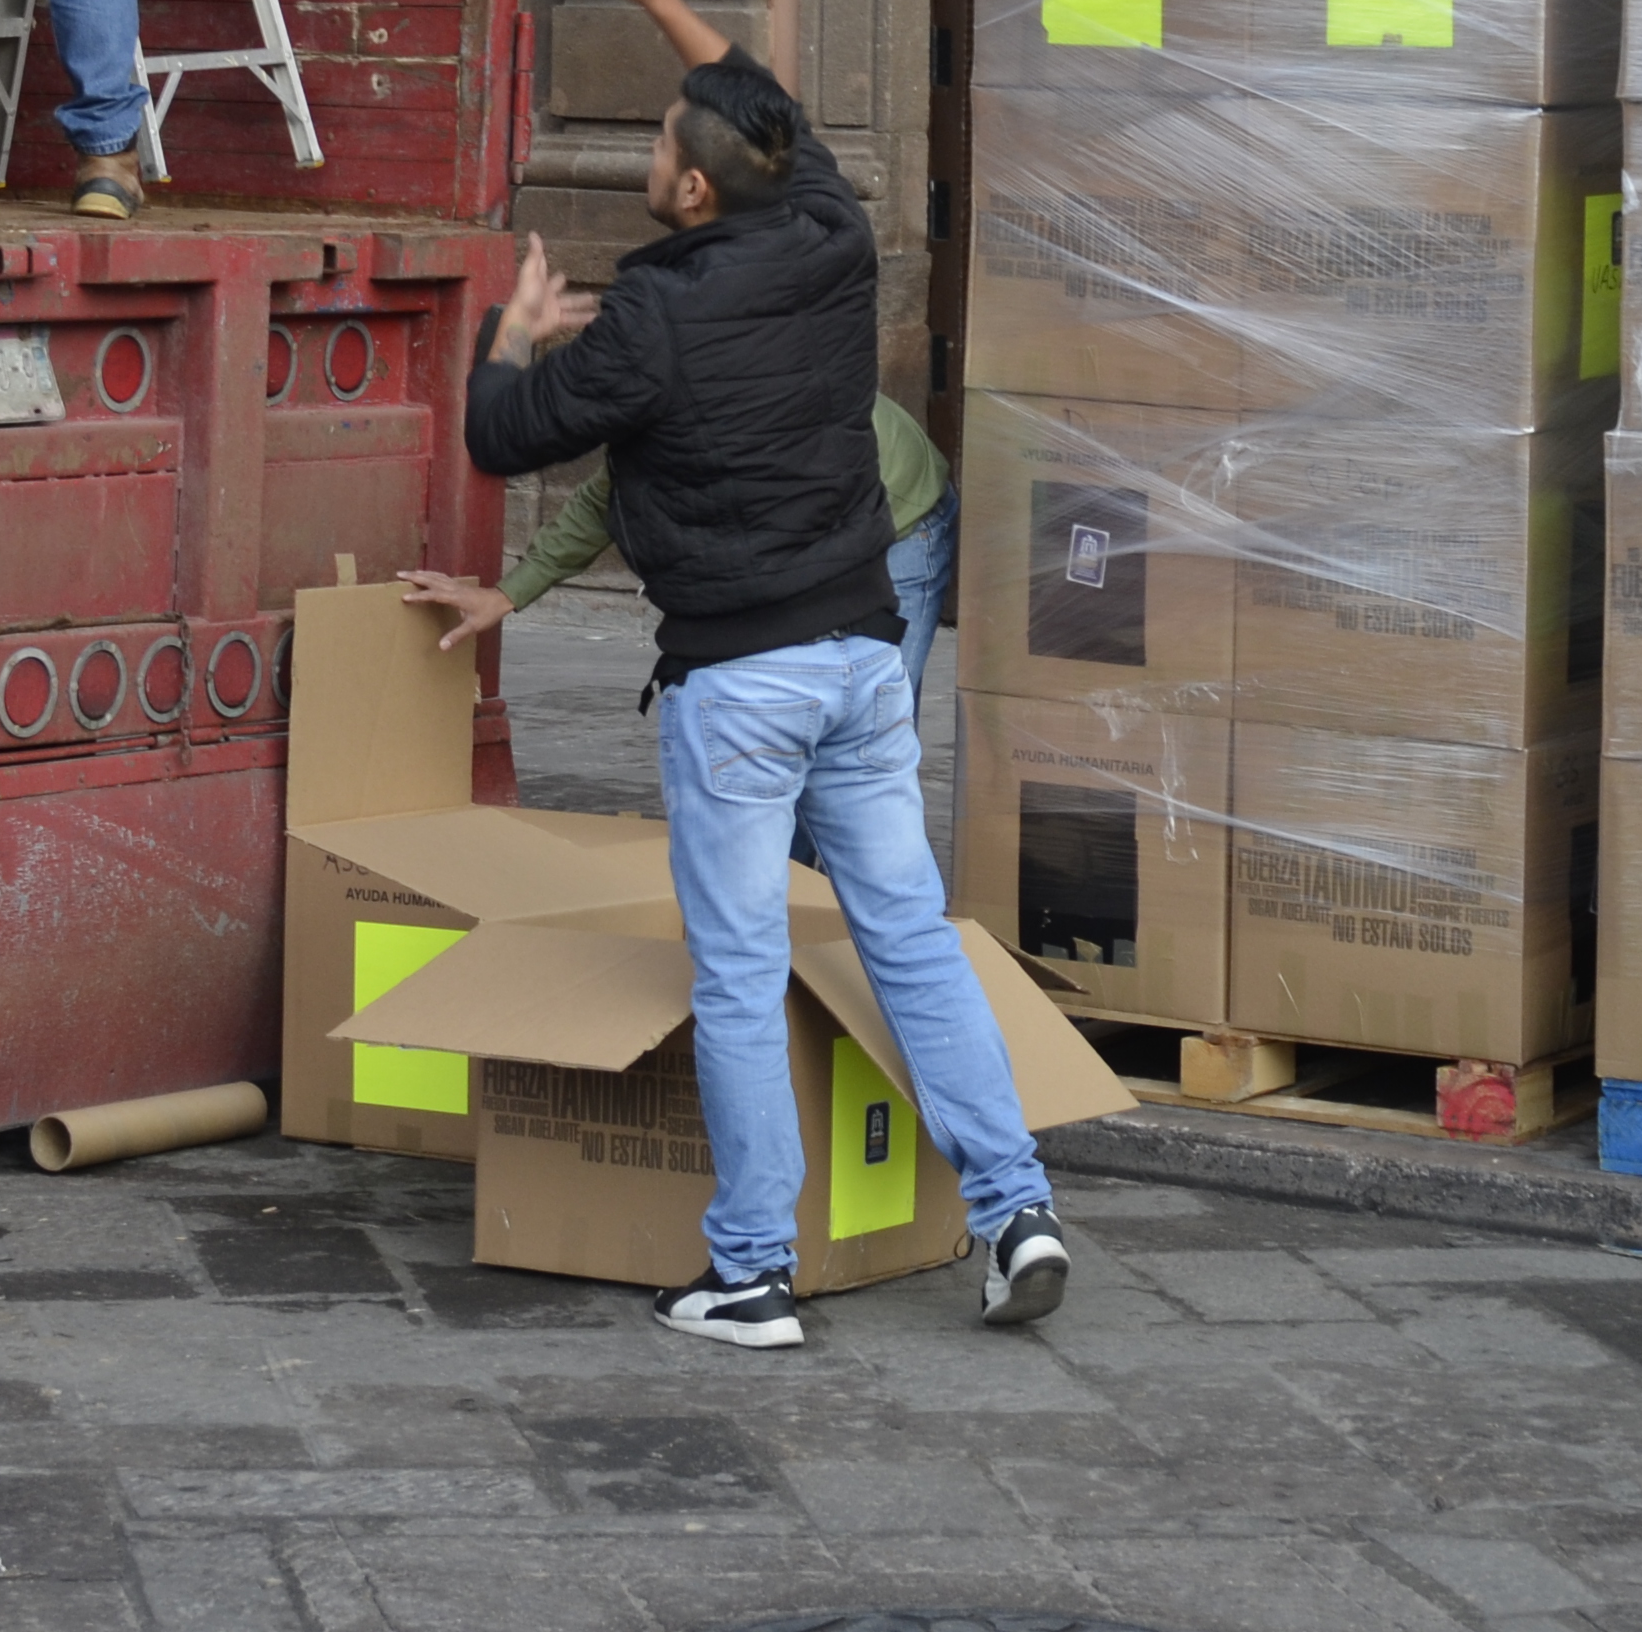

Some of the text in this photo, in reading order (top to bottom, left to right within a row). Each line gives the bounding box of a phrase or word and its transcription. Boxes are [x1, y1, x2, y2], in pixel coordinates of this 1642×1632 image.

[1592, 263, 1621, 295] UAS
[1335, 600, 1358, 631] NO
[1421, 608, 1475, 641] SOLOS
[1011, 748, 1155, 776] AYUDA HUMANITARIA
[1237, 847, 1301, 886] FUERZA
[346, 887, 445, 909] AYUDA HUMA
[1248, 897, 1510, 928] SIGAN ADELANTE SIEMPRE FUERTES
[1332, 914, 1356, 943] NO
[1418, 926, 1473, 957] SOLOS
[483, 1057, 549, 1099] FUERZA
[494, 1114, 526, 1137] SIGAN
[528, 1117, 582, 1144] ADELANTE
[581, 1129, 717, 1176] NO ESTÁN SOLO
